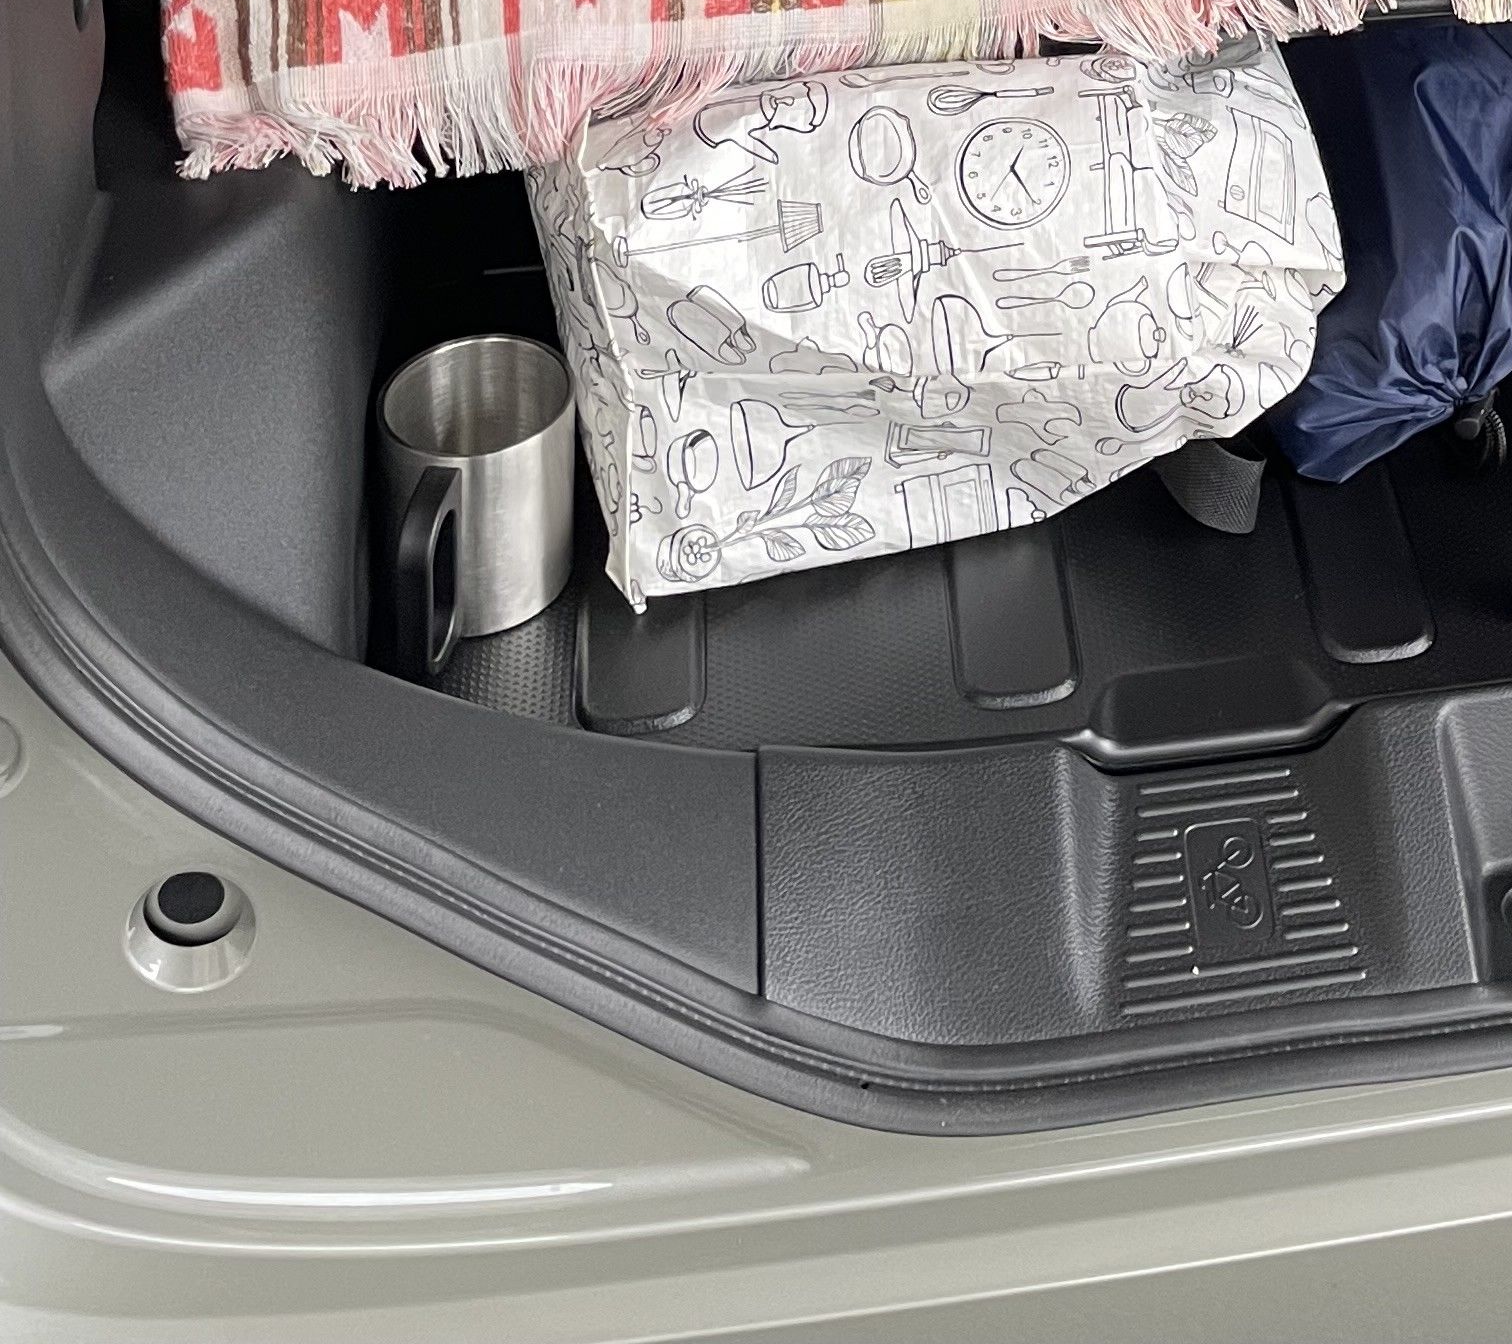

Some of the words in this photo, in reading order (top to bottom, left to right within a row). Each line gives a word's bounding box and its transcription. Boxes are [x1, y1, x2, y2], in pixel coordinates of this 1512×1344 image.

[982, 134, 994, 142] 8
[1021, 127, 1033, 140] 10
[1038, 138, 1050, 149] 11
[971, 150, 981, 158] 7
[1046, 155, 1060, 170] 12
[1010, 207, 1023, 217] 3
